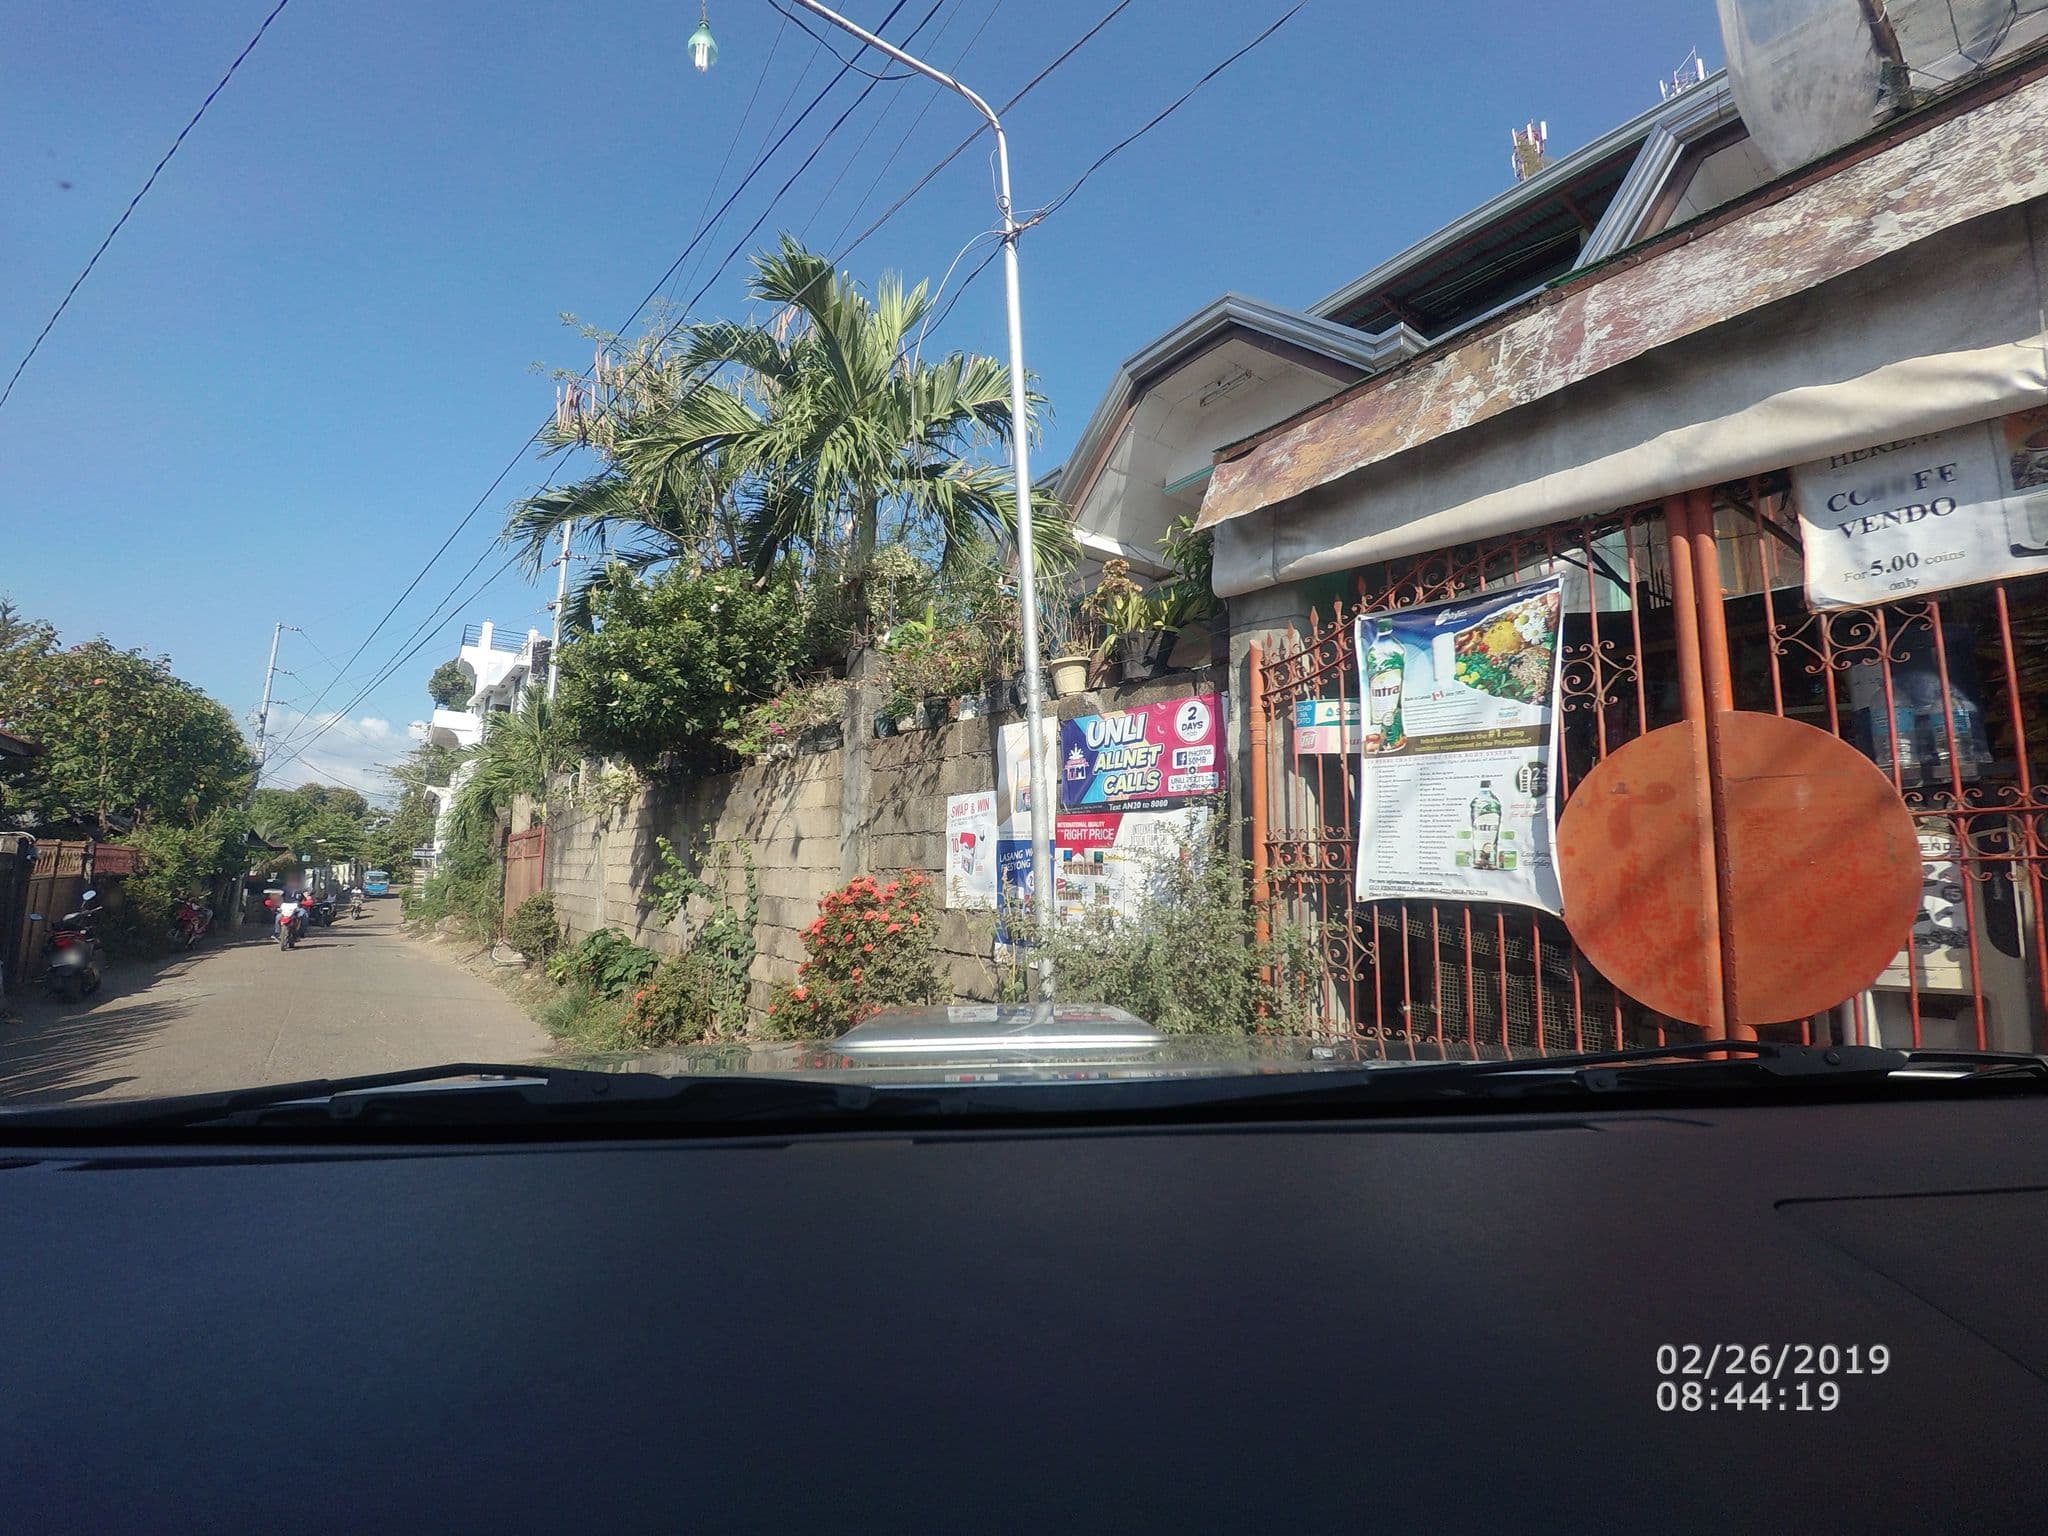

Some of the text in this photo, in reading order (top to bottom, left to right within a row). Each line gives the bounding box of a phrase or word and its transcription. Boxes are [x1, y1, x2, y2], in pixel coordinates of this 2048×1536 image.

[1837, 496, 1957, 539] VENDO
[1843, 549, 1967, 583] For 5.00 coins
[1889, 577, 1920, 591] only
[1187, 706, 1197, 721] 2
[1086, 711, 1149, 750] UNLI
[1181, 720, 1204, 732] DAYS
[1093, 743, 1164, 773] ALLNET
[1102, 769, 1163, 796] CALLS
[977, 798, 990, 813] WIN
[1108, 803, 1121, 811] Text
[1063, 828, 1088, 841] RIGHT
[1088, 828, 1115, 841] PRICE
[999, 849, 1024, 864] LASANG
